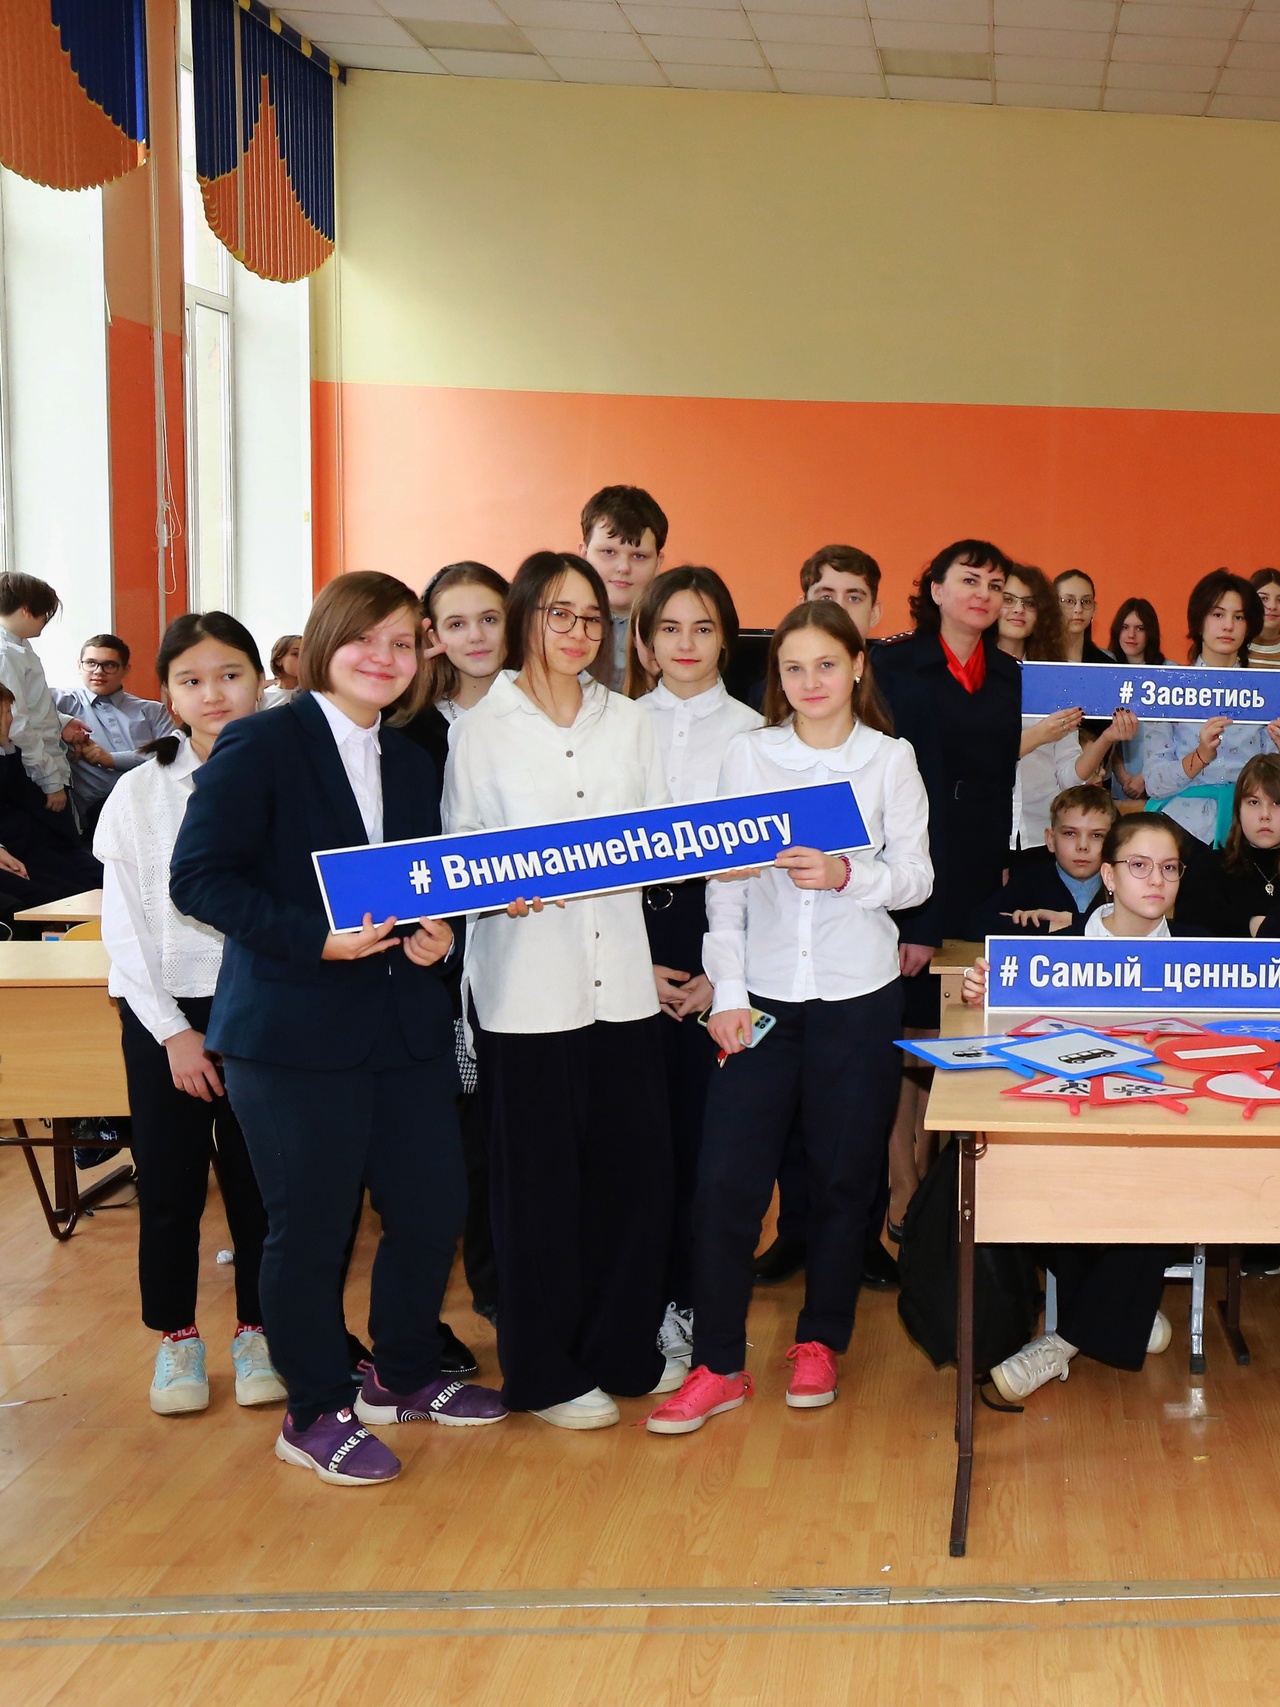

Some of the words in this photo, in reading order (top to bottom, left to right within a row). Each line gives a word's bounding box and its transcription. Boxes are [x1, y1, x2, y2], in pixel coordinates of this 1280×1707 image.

[1119, 681, 1134, 704] #
[1141, 680, 1265, 708] Засветись
[409, 860, 432, 895] #
[441, 811, 792, 891] ВниманиеНаДорогу
[999, 955, 1019, 987] #
[430, 1380, 464, 1411] REIKE
[328, 1436, 361, 1473] REIKE
